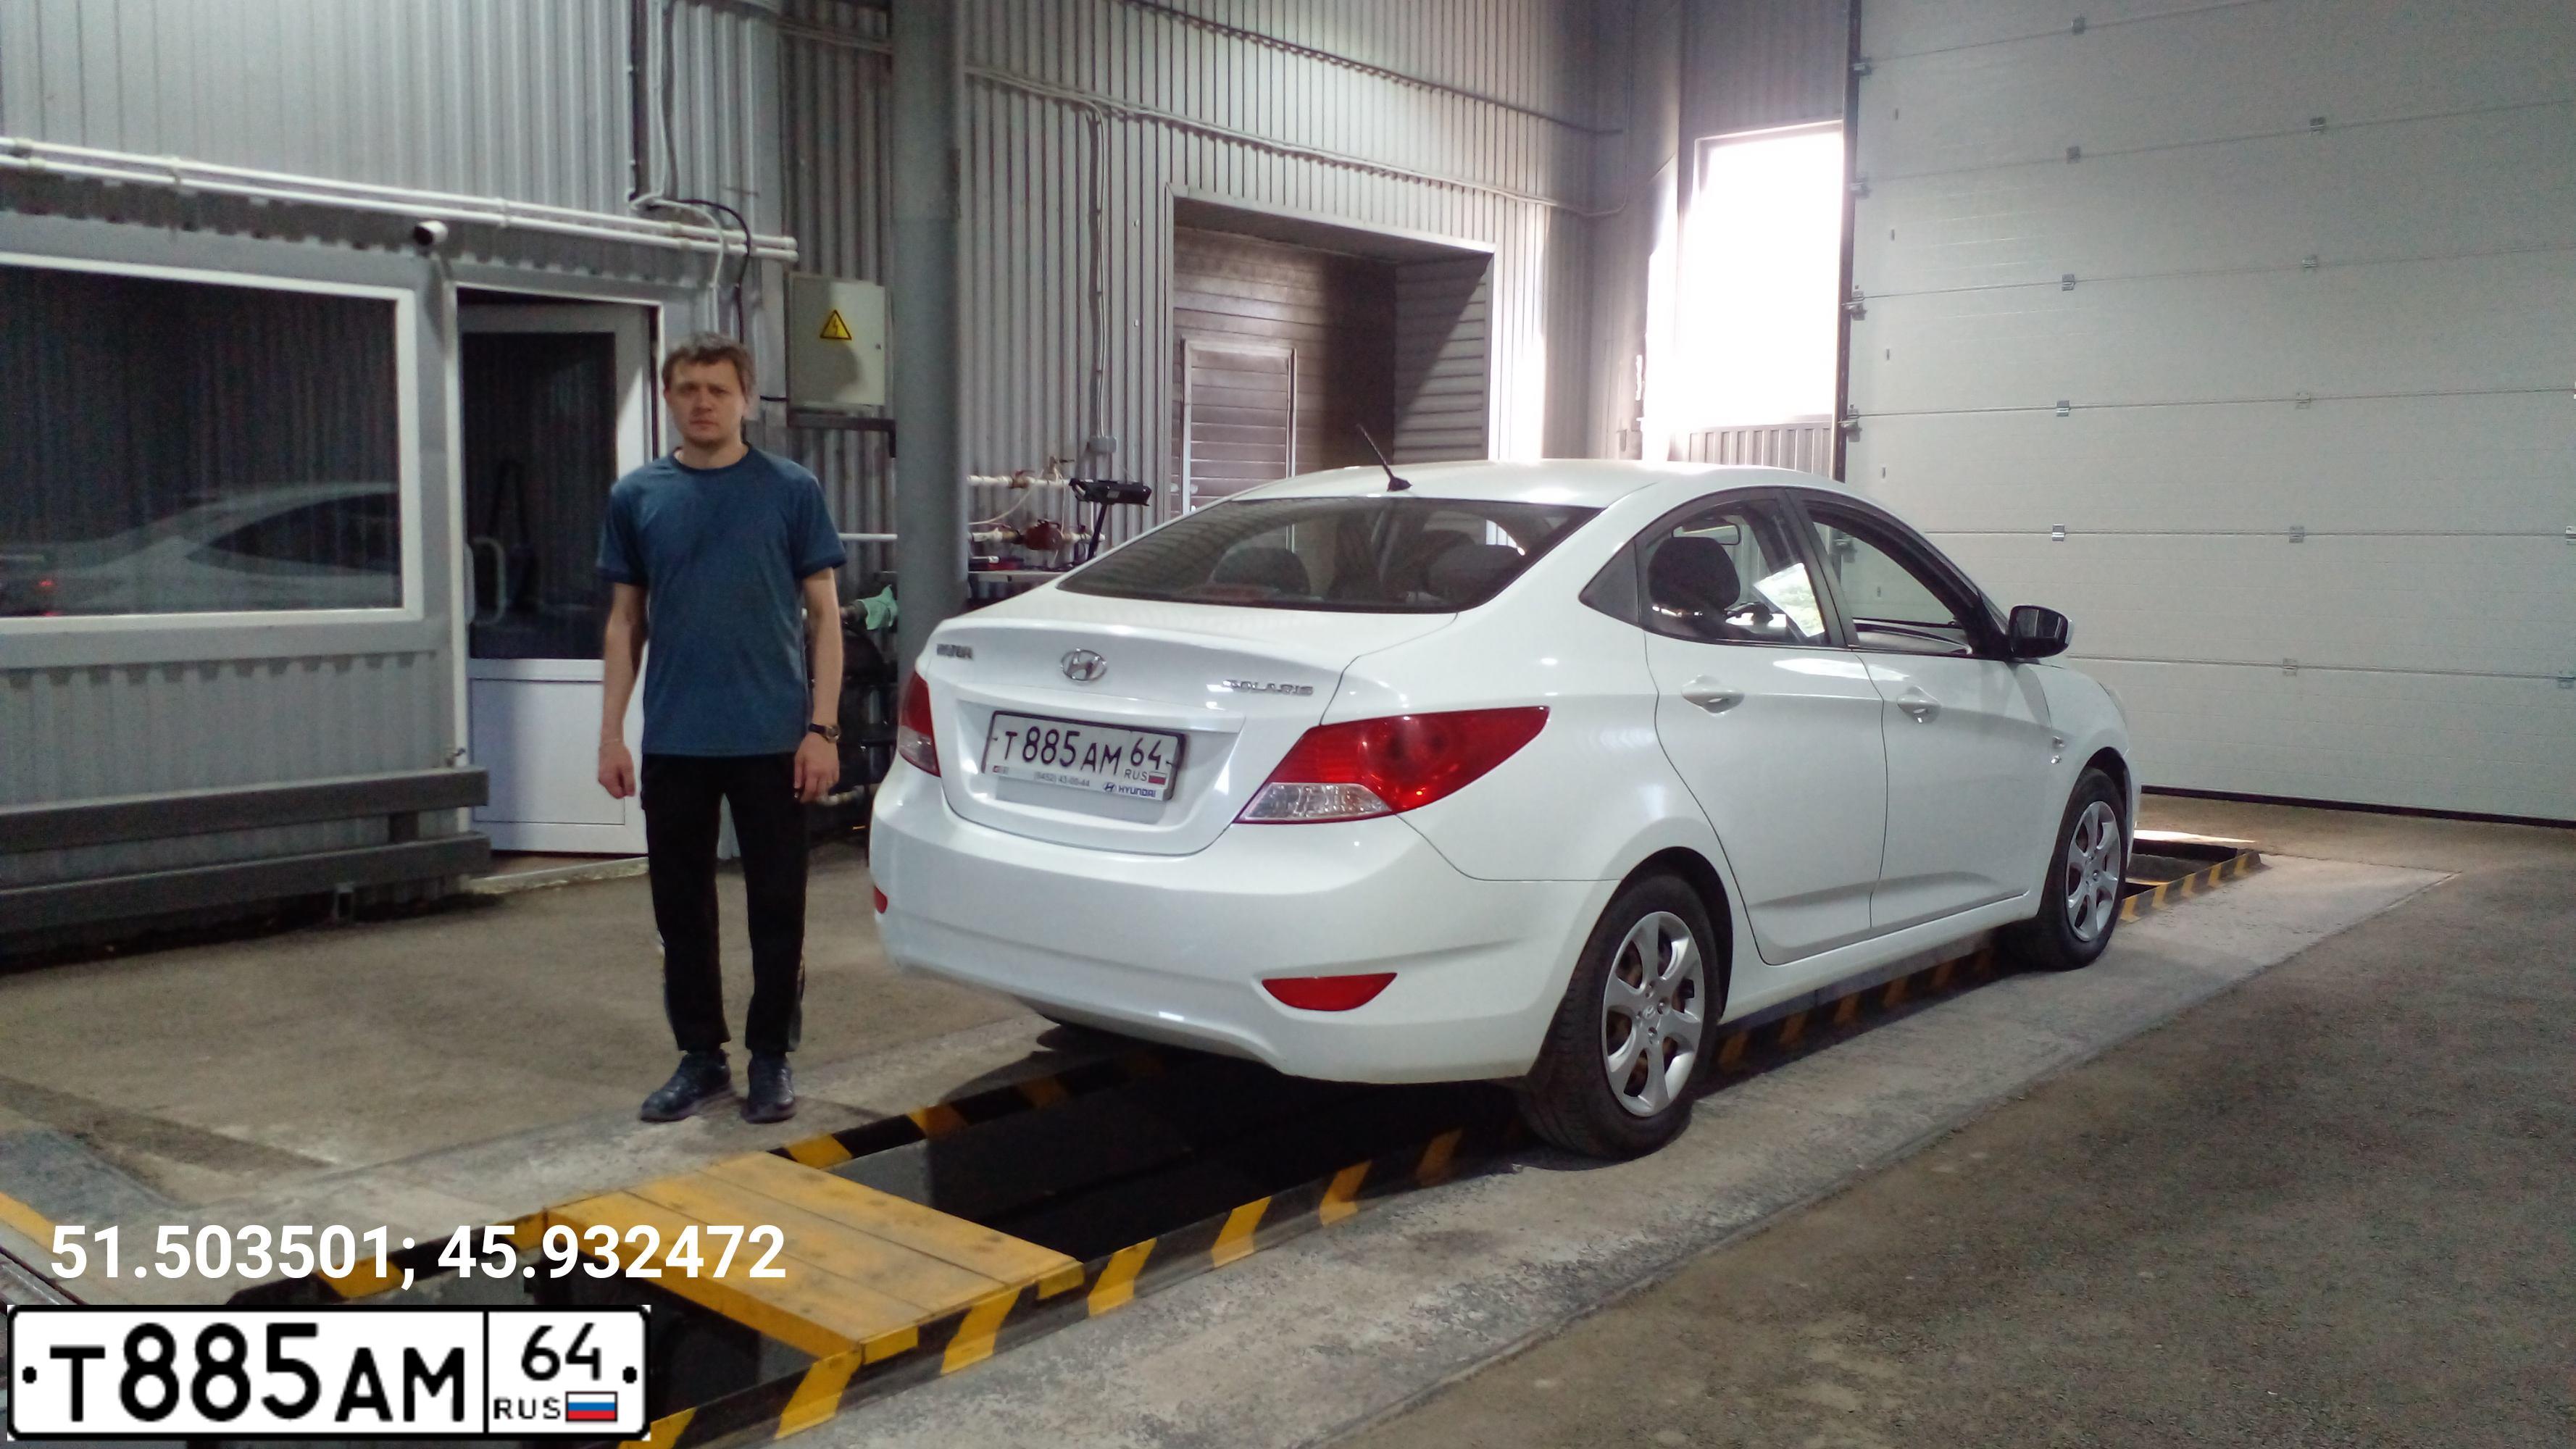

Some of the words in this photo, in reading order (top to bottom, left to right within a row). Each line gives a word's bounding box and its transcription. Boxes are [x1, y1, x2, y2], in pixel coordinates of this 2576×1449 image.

[1130, 738, 1162, 770] 64
[1125, 769, 1148, 782] RUS
[1118, 785, 1156, 798] HYUNDAI
